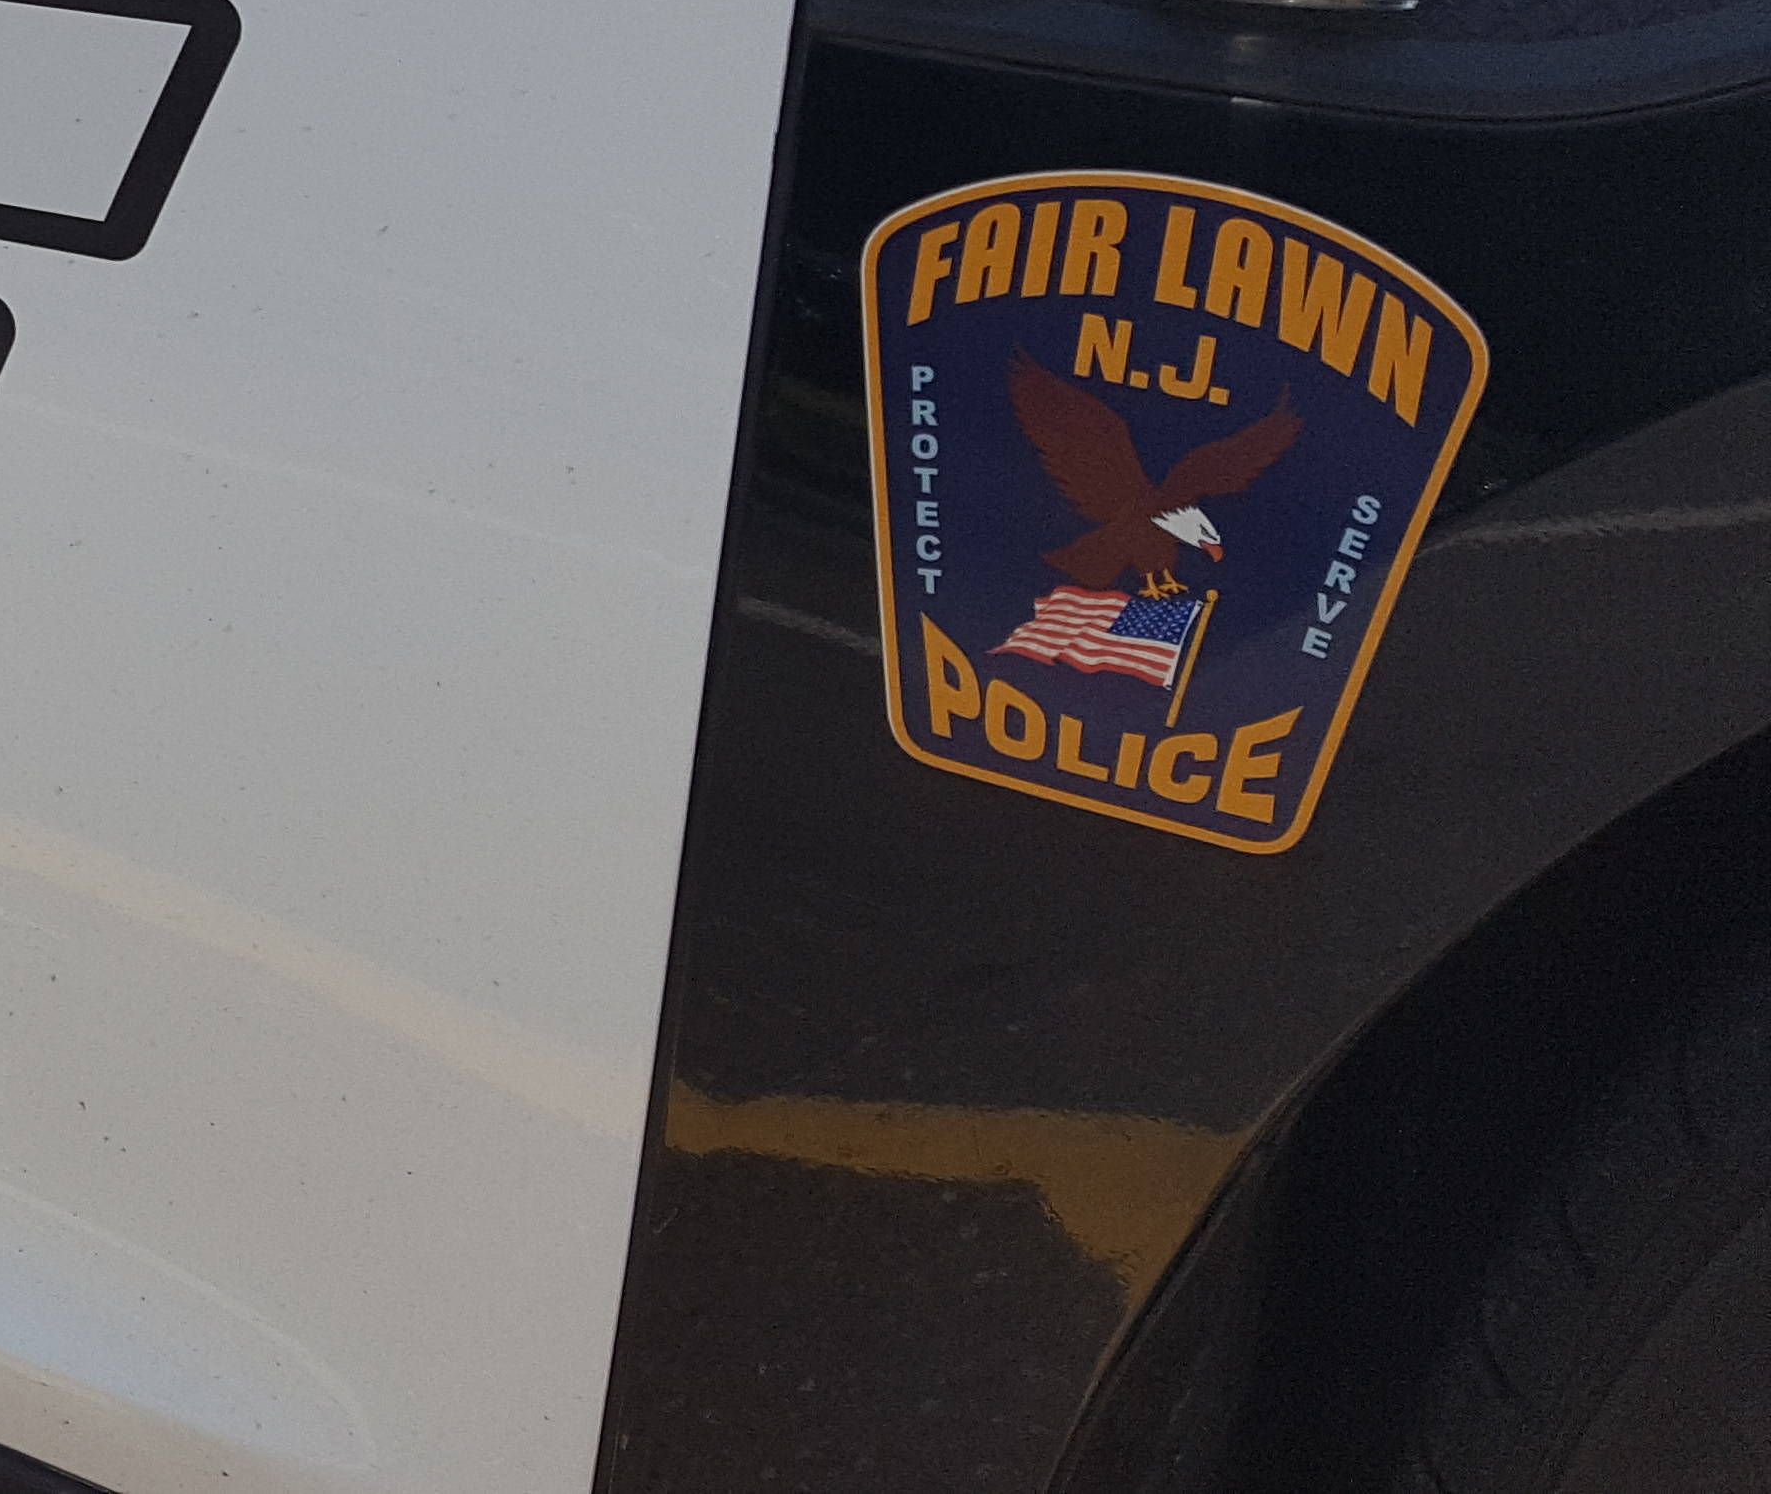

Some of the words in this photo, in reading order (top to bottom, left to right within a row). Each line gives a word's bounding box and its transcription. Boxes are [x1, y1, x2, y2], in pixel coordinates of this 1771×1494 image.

[906, 198, 1130, 327] FAIR
[1154, 204, 1434, 429] LAWN
[1072, 312, 1231, 407] N.J.
[910, 365, 943, 595] PROTECT
[1301, 494, 1382, 661] SERVE
[920, 610, 1304, 825] POLICE
